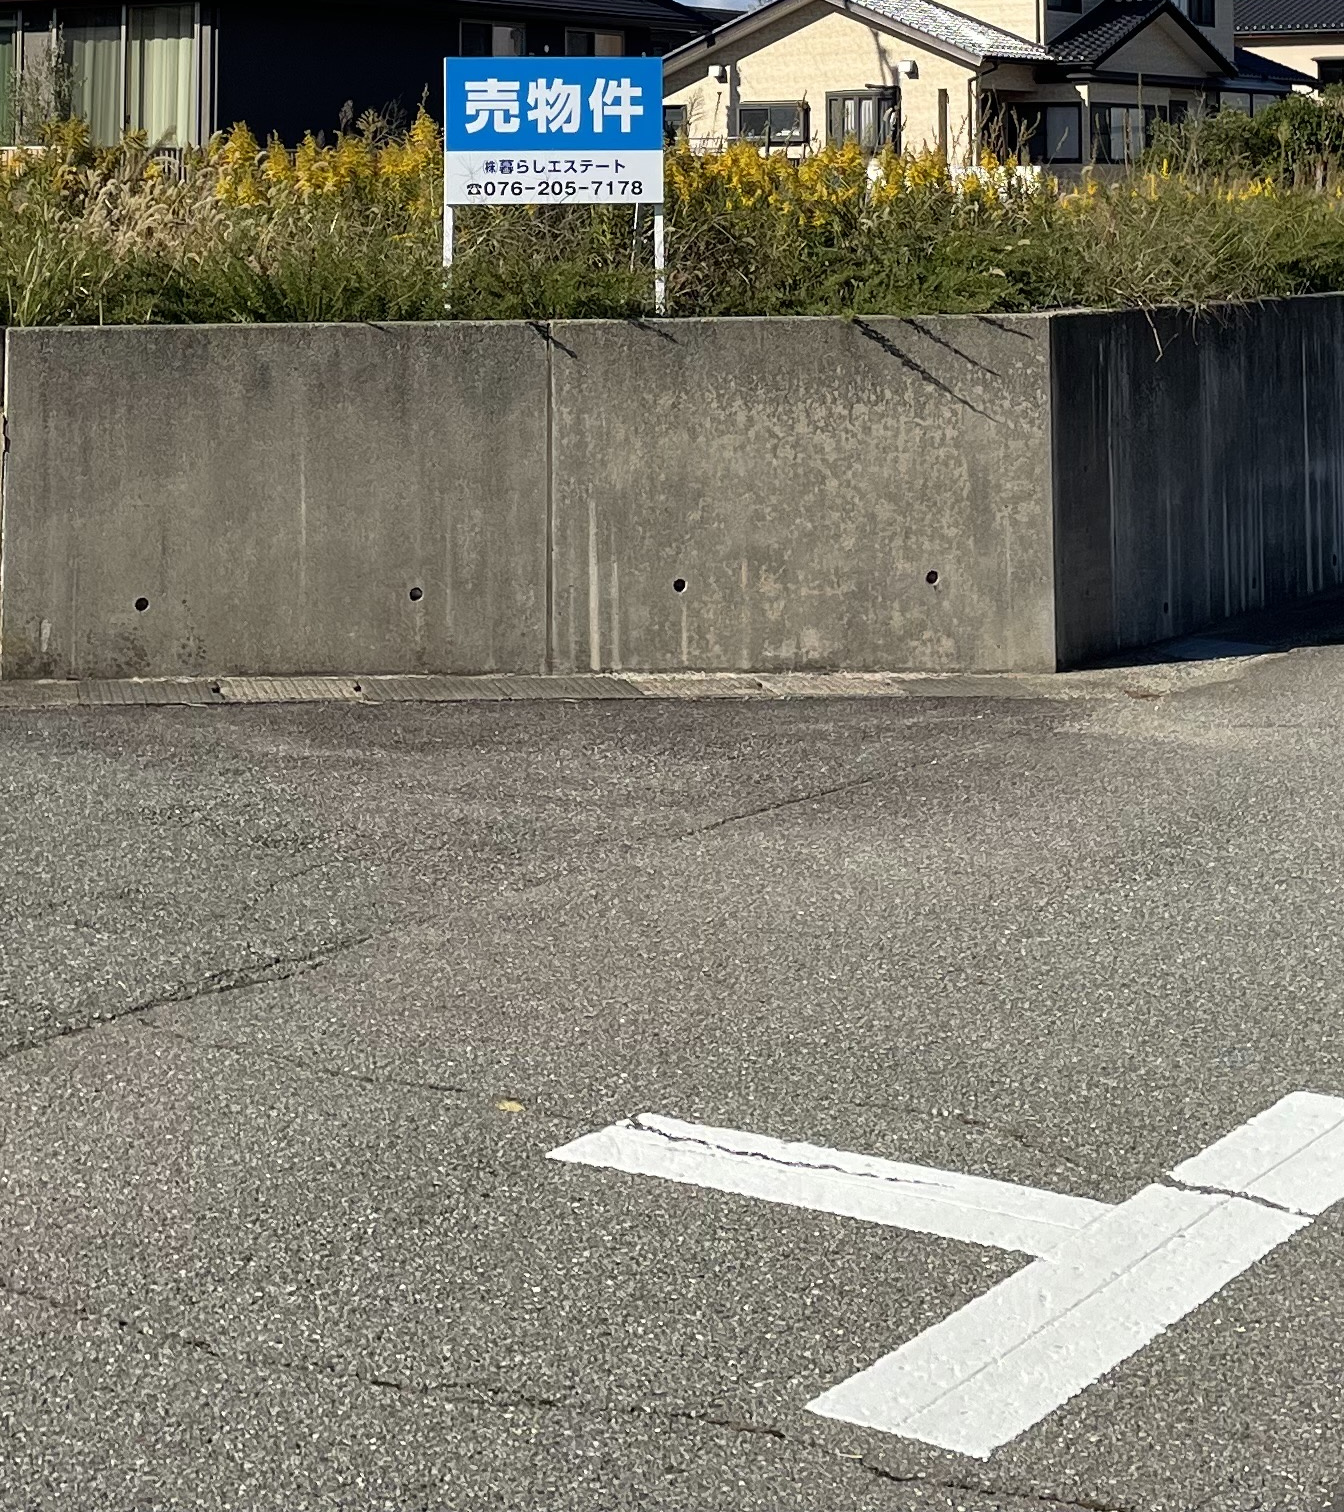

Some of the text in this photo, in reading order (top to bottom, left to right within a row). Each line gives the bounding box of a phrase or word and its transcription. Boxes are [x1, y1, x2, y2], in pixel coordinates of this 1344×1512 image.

[464, 78, 644, 134] 売物件
[483, 180, 643, 196] 076-205-7178
